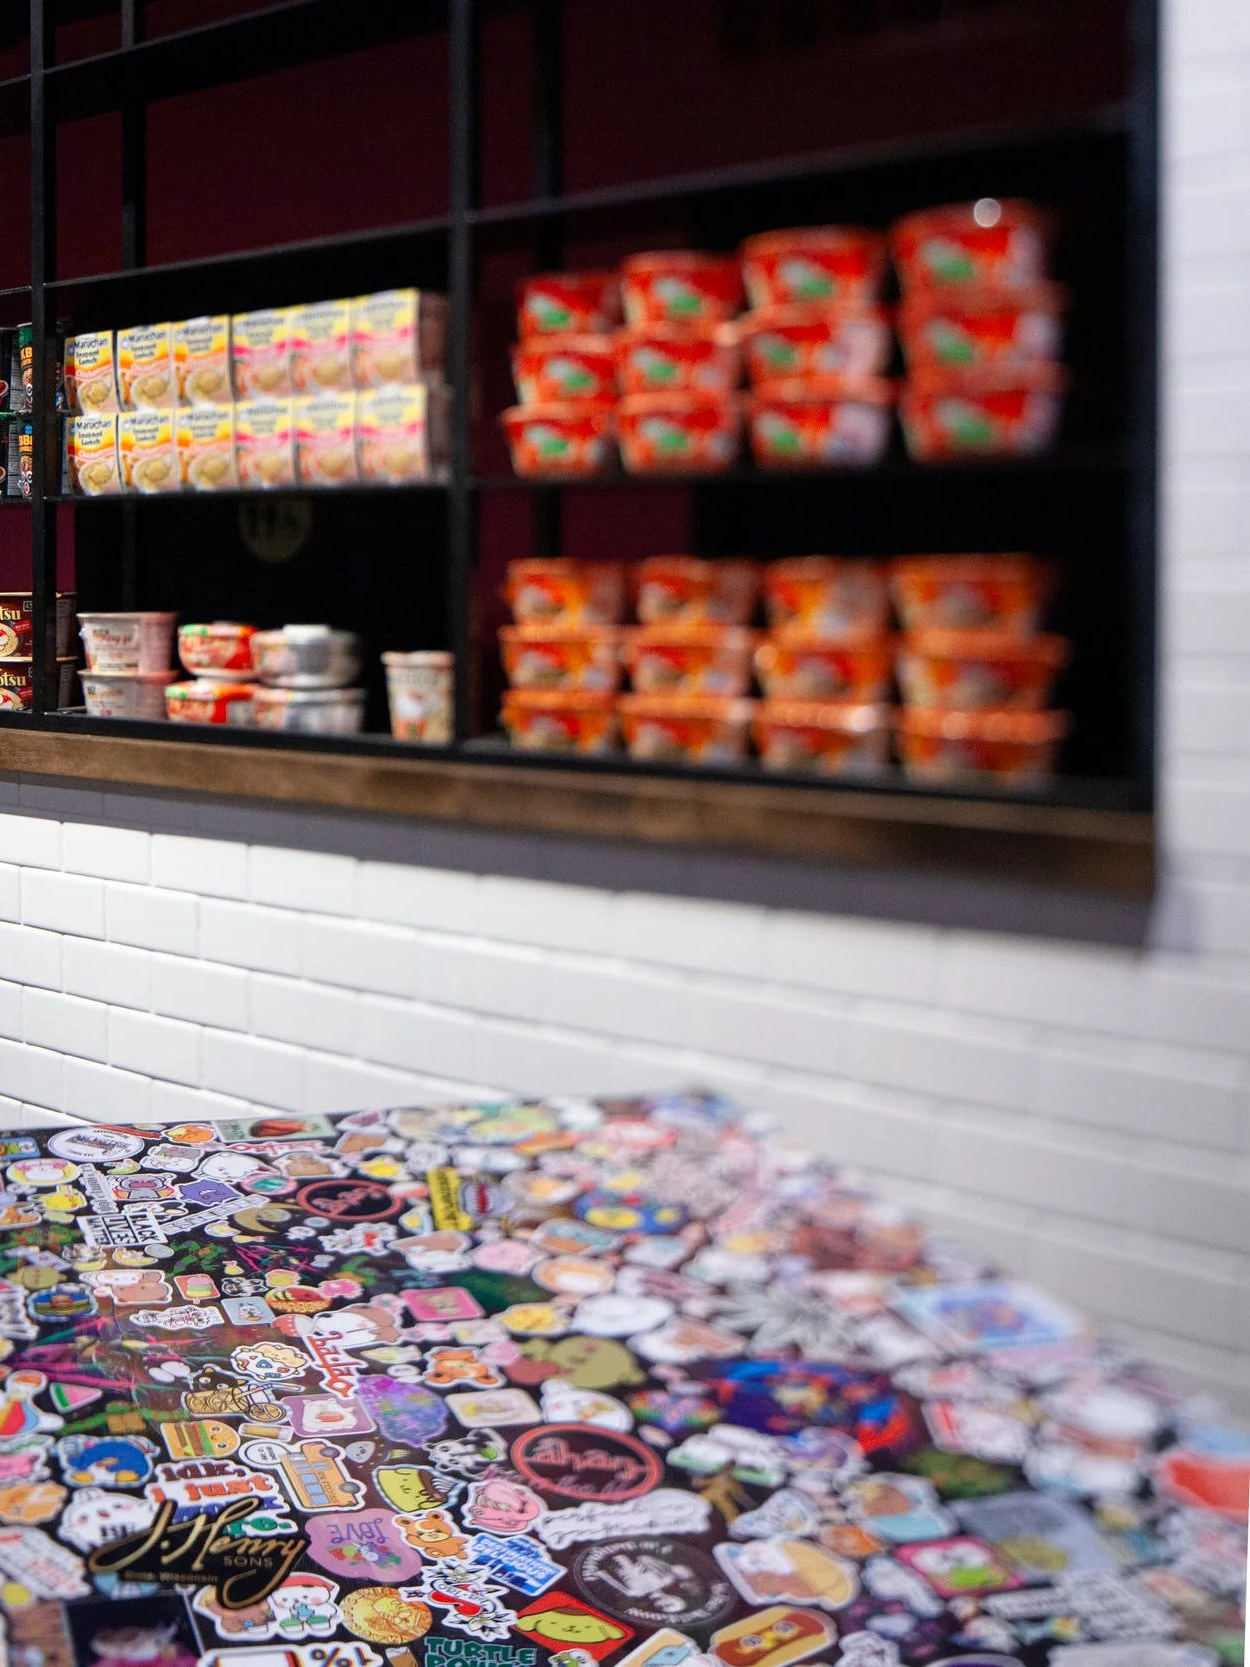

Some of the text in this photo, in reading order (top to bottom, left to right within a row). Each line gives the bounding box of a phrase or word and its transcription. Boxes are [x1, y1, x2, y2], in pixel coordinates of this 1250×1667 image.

[129, 330, 166, 342] Maruchan
[74, 337, 108, 350] Maruchan
[76, 350, 99, 358] Instant
[79, 357, 98, 366] Lunch
[77, 419, 111, 430] Maruchan
[78, 431, 102, 439] Instant
[81, 438, 100, 446] Lunch
[110, 1215, 133, 1243] LIVES
[130, 1214, 160, 1242] BLACK
[160, 1496, 307, 1610] Henry
[223, 1556, 274, 1569] SONS
[425, 1636, 537, 1665] TURTLE
